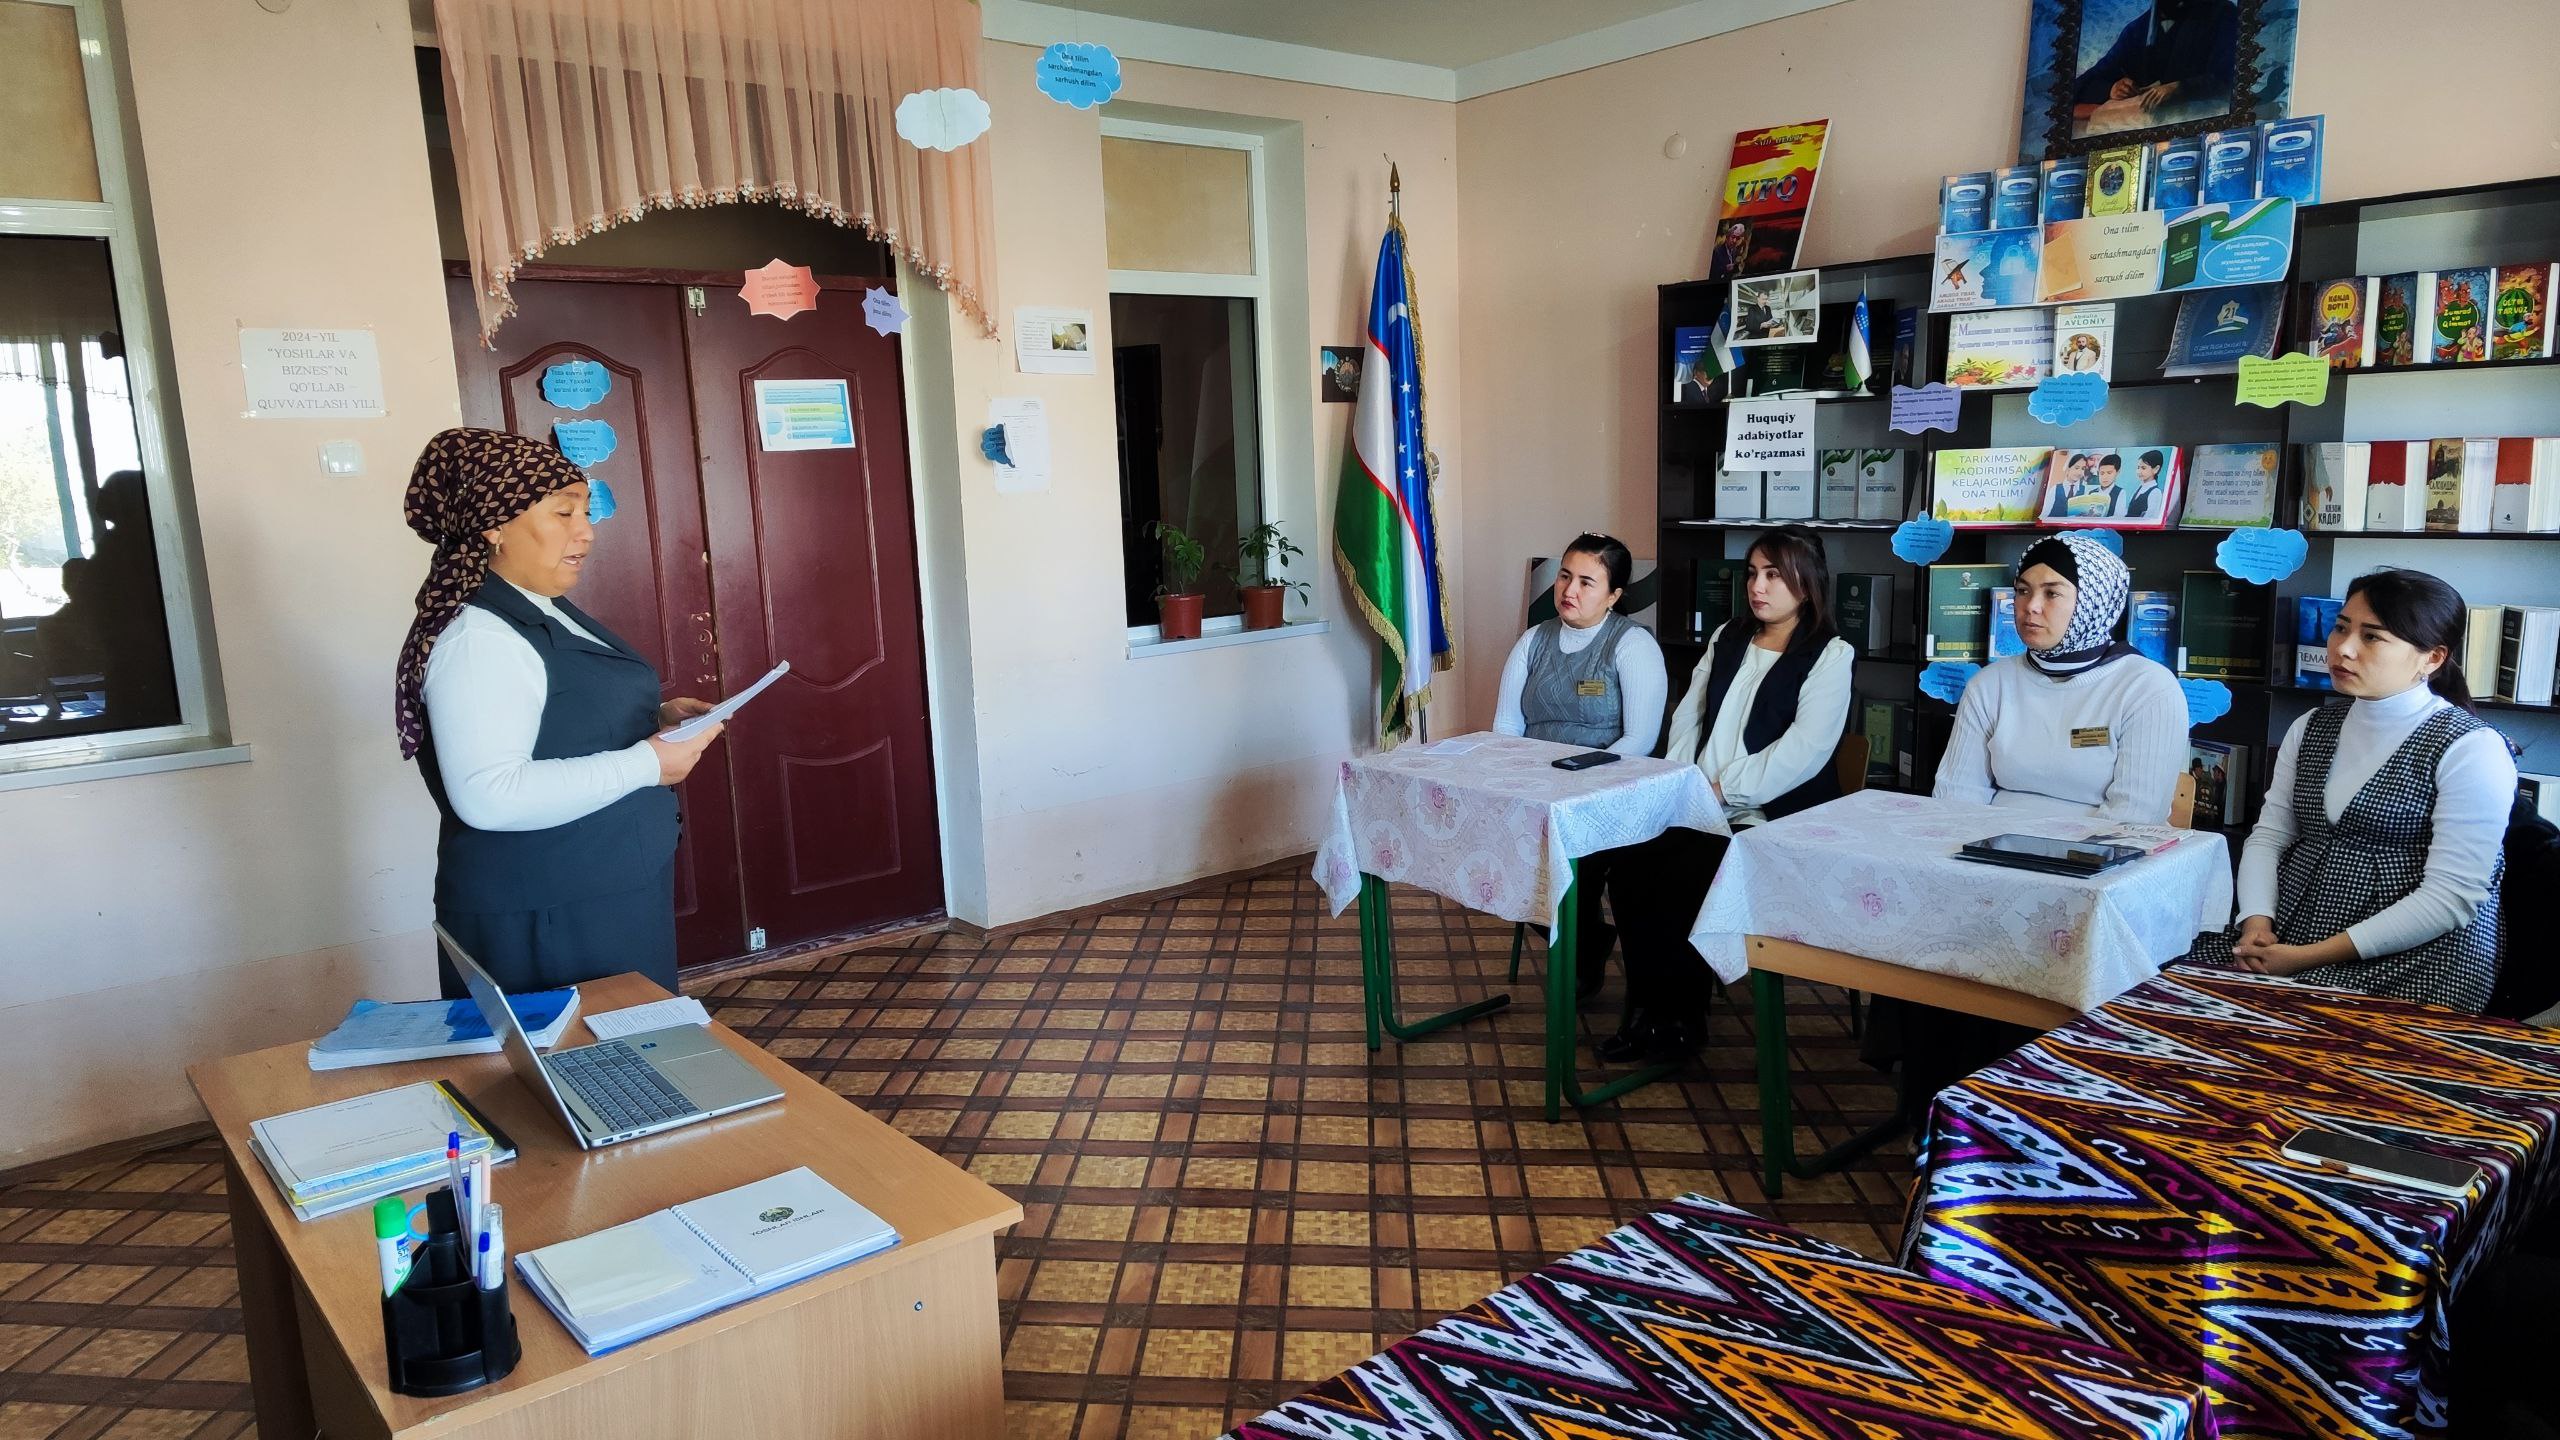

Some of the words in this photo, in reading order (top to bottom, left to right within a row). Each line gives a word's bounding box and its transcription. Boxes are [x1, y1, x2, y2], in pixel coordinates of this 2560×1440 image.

[1048, 63, 1102, 77] sarchashmangdan
[1736, 174, 1798, 204] UFQ
[2103, 225, 2119, 236] Ona
[2121, 222, 2140, 234] tilim
[2089, 246, 2157, 262] sarchashmangdan
[2094, 273, 2124, 285] sarxush
[2124, 269, 2145, 281] dilim
[2327, 302, 2350, 311] BOTIR
[2502, 298, 2524, 307] OLTIN
[2224, 307, 2235, 319] 21
[2443, 307, 2471, 316] Zumrad
[2497, 306, 2528, 315] TARVUZ
[2064, 318, 2106, 326] AVLONIY
[281, 331, 341, 343] 2024-YIL
[338, 349, 357, 359] VA
[289, 381, 345, 393] QO'LLAB
[1771, 378, 1777, 386] 6
[257, 398, 349, 410] QUVVATLASH
[1746, 412, 1796, 425] Huquqiy
[1737, 430, 1804, 442] adabiyotlar
[1735, 447, 1806, 460] ko'rgazmasi
[1959, 454, 2031, 465] TARIXIMSAN,
[1953, 466, 2035, 476] TAQDIRIMSAN,
[1952, 476, 2036, 487] KELAJAGIMSAN
[1962, 489, 1987, 498] ONA
[1990, 489, 2024, 498] TILIM!
